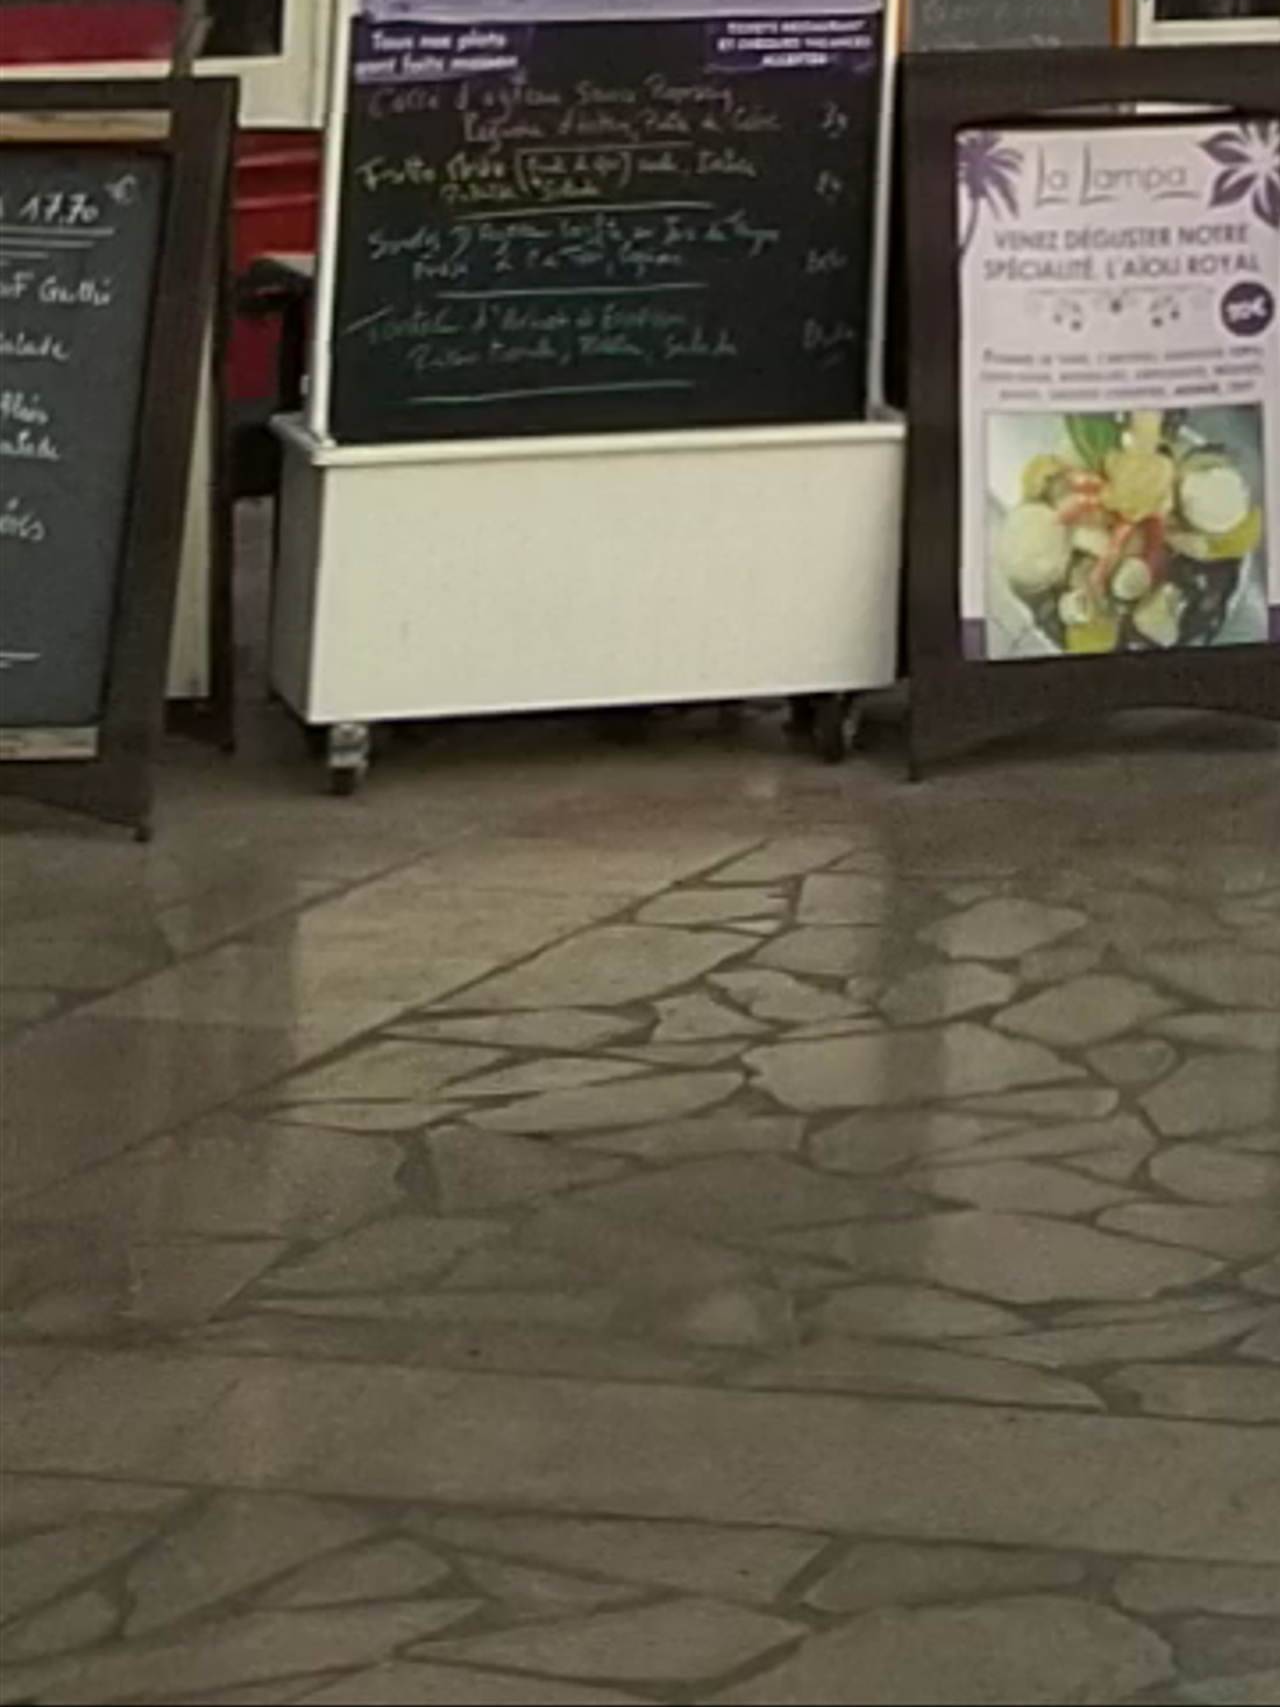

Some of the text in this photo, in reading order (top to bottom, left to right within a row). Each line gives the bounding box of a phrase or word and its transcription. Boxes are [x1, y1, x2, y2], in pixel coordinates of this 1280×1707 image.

[1034, 141, 1200, 207] La Lampa
[993, 222, 1250, 253] VENEZ DÉGUSTER NOTRE
[1187, 251, 1260, 276] ROYAL
